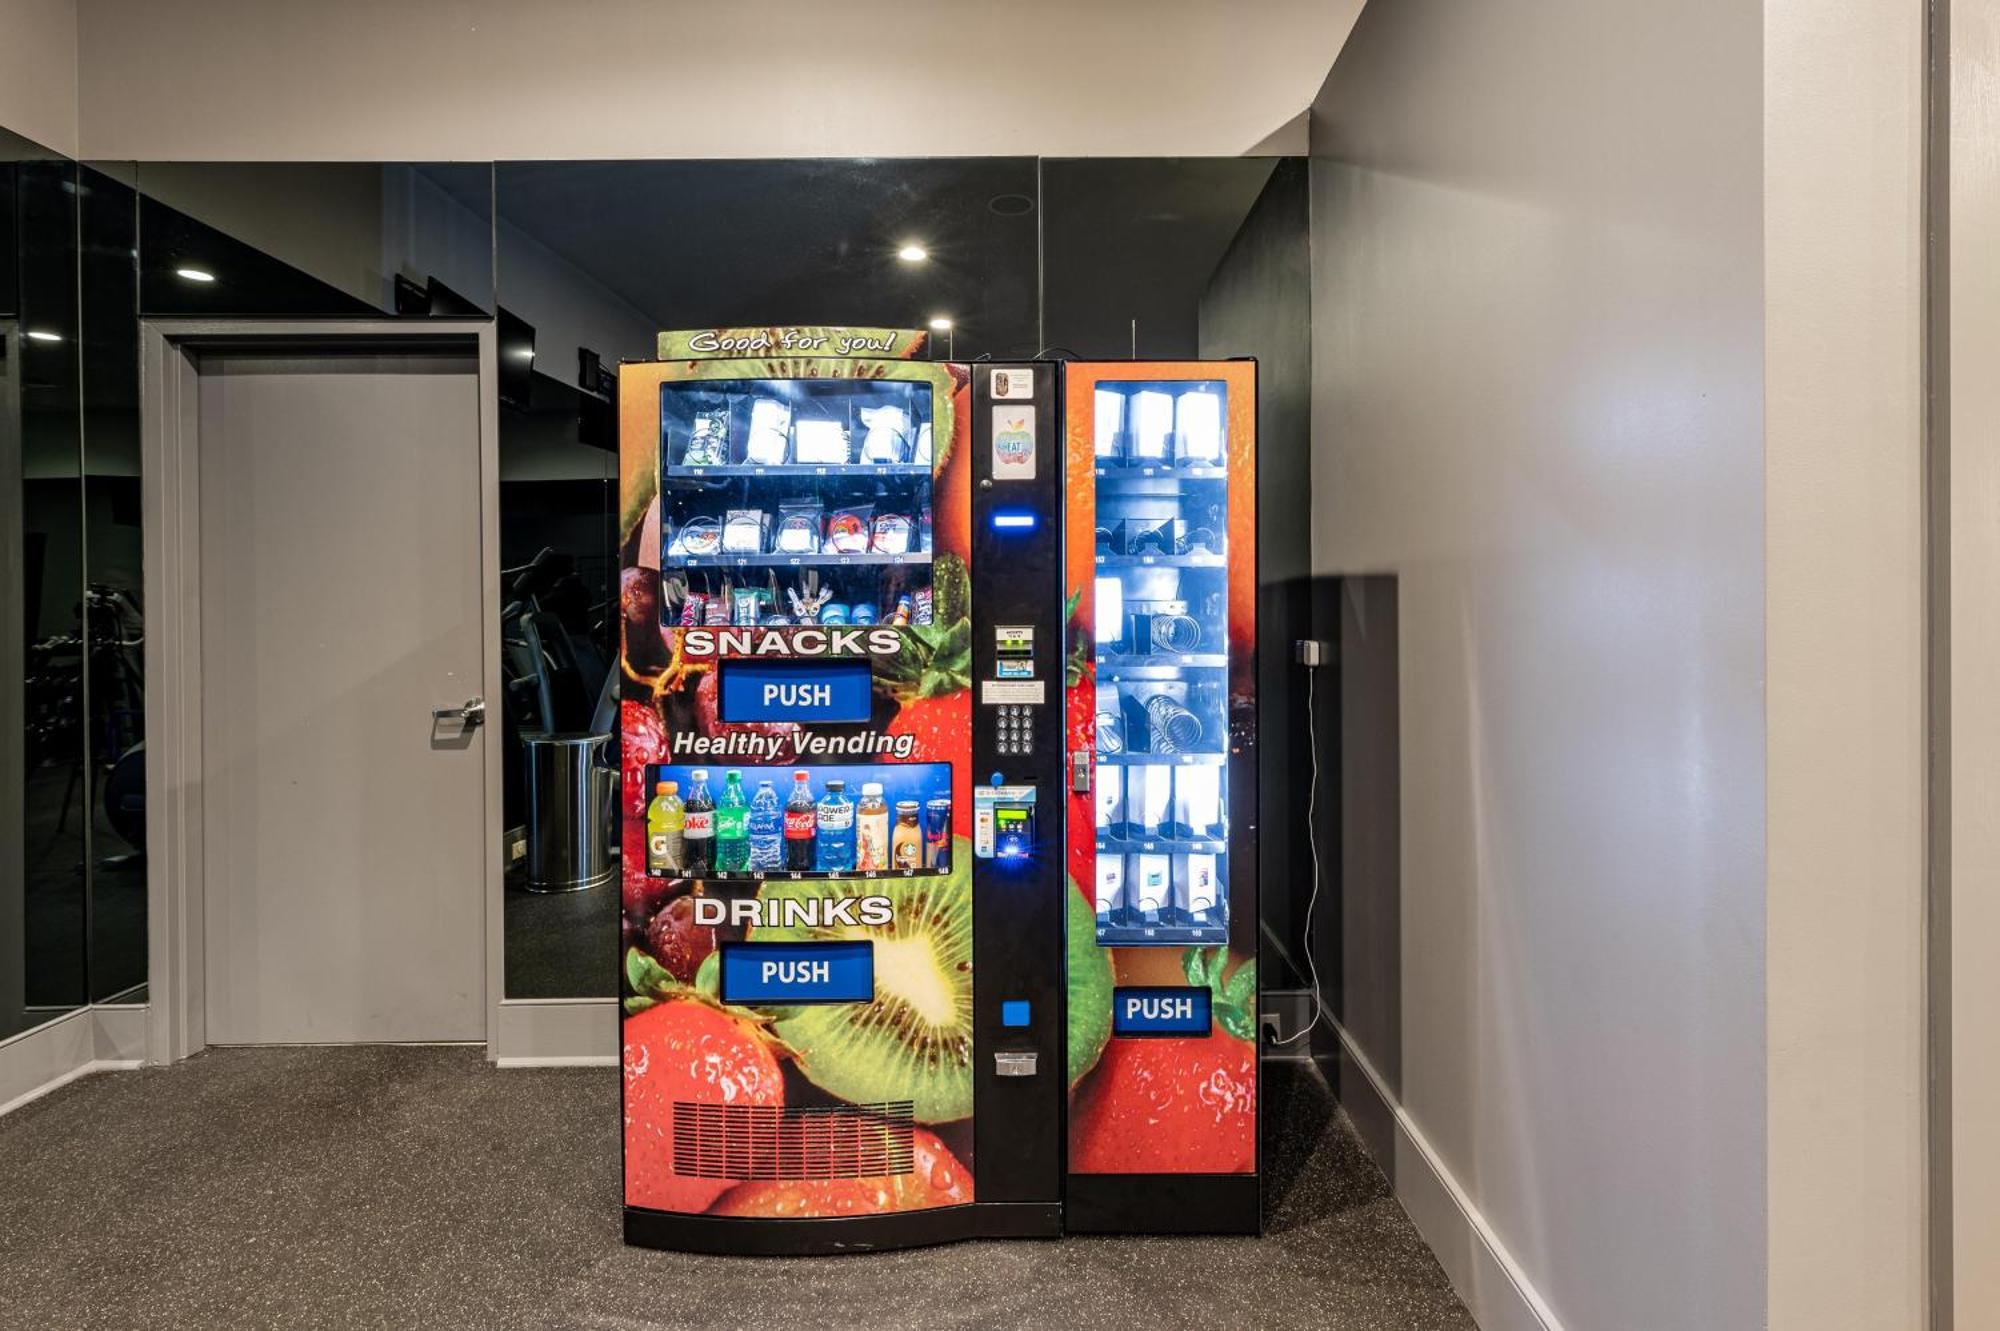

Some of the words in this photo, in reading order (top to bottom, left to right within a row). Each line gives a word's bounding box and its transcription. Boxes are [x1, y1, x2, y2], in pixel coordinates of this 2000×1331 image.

[688, 330, 771, 352] Good
[780, 331, 829, 350] for
[836, 331, 897, 354] you!
[684, 629, 902, 656] SNACKS
[763, 684, 831, 707] PUSH
[673, 731, 785, 761] Healthy
[791, 731, 914, 759] Vending
[682, 870, 692, 878] 141
[717, 871, 728, 879] 142
[753, 872, 764, 880] 143
[790, 872, 801, 880] 144
[865, 871, 877, 879] 146
[694, 896, 894, 928] DRINKS
[762, 960, 830, 984] PUSH
[1126, 998, 1192, 1020] PUSH
